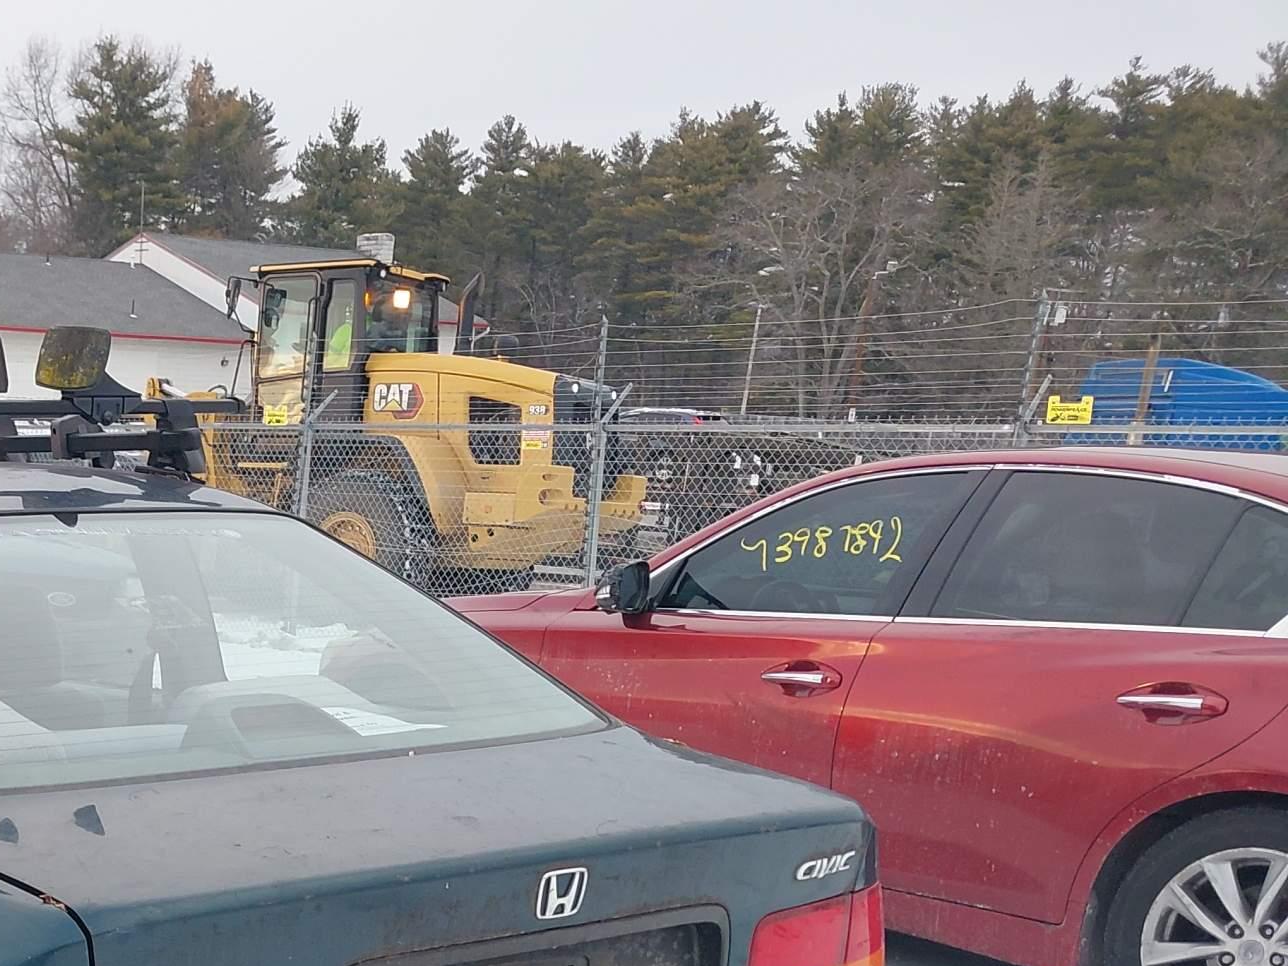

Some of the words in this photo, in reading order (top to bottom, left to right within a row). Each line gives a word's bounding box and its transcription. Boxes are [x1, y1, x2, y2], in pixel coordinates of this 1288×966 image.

[373, 383, 413, 411] CAT
[741, 516, 903, 572] 43987892
[796, 850, 856, 880] CIVIC
